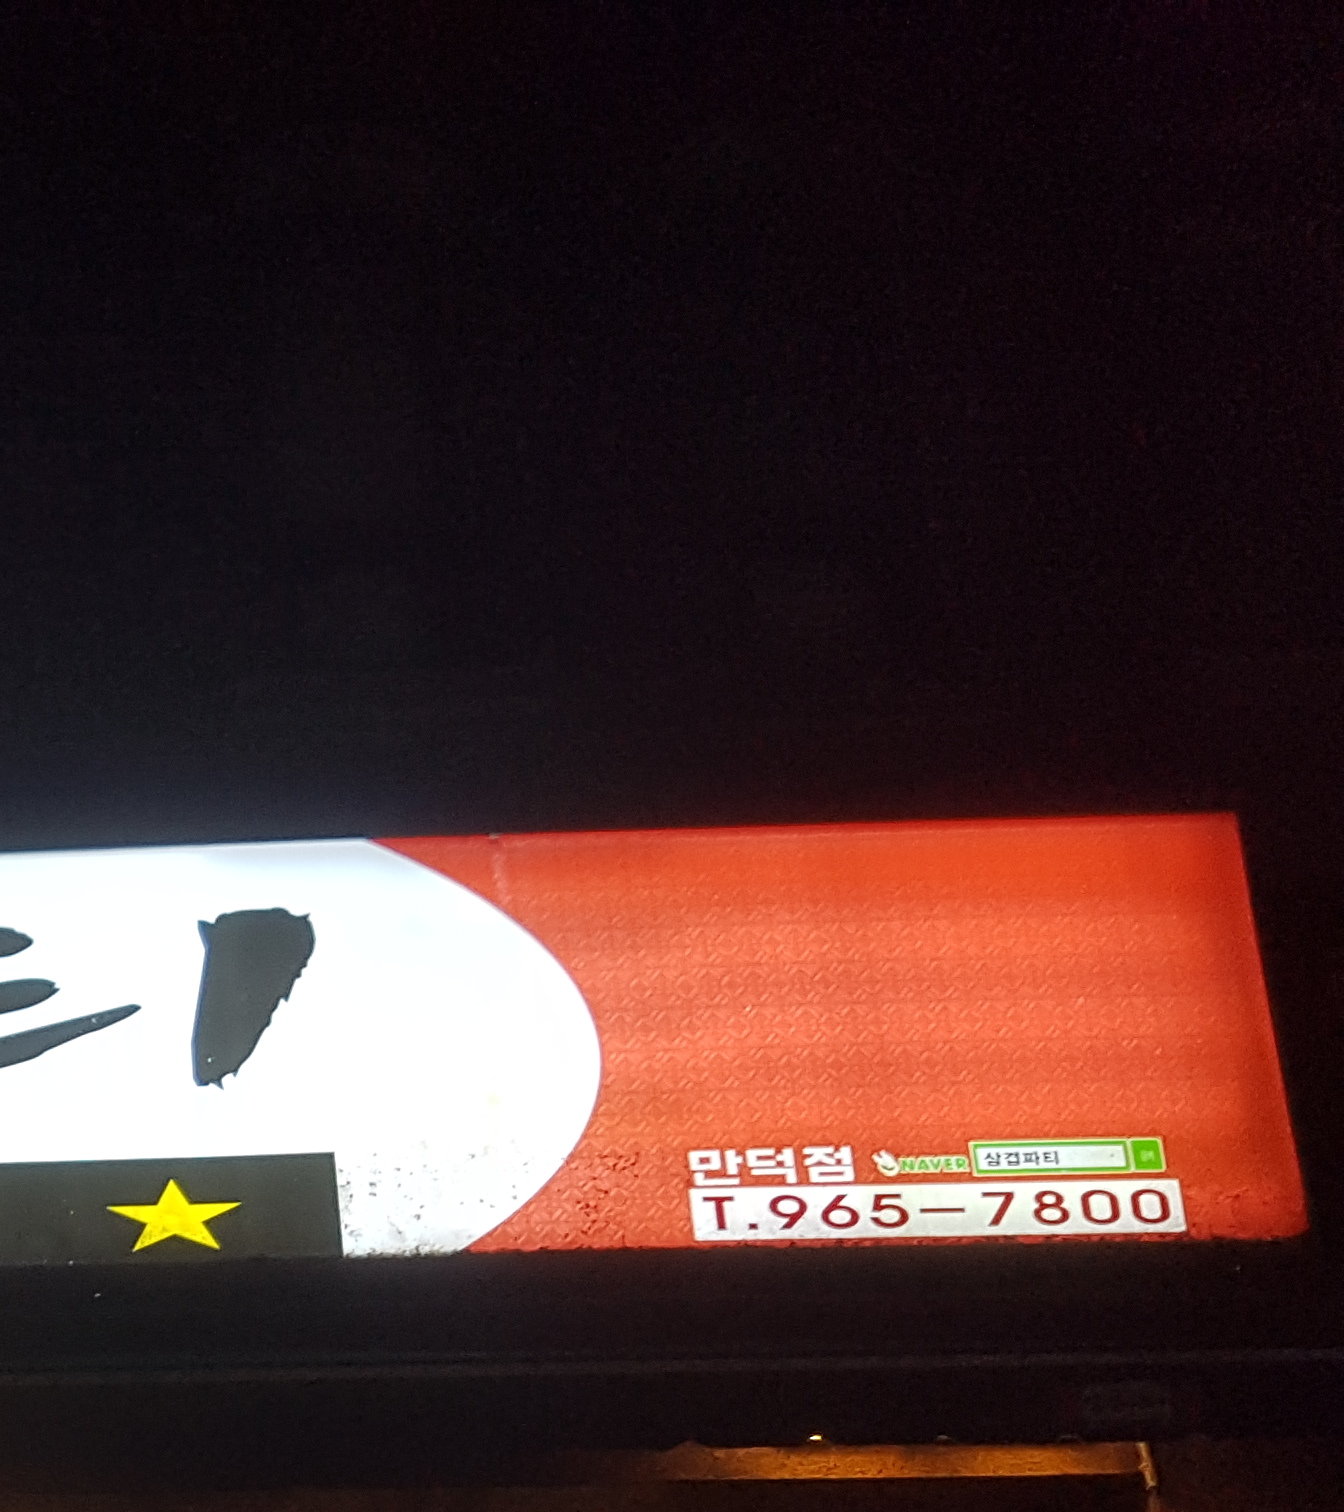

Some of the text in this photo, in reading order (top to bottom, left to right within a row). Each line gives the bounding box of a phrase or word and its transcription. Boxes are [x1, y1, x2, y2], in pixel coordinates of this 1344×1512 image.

[687, 1146, 855, 1187] 만덕점
[900, 1155, 969, 1173] NAVER
[984, 1150, 1060, 1167] 삼겹파티
